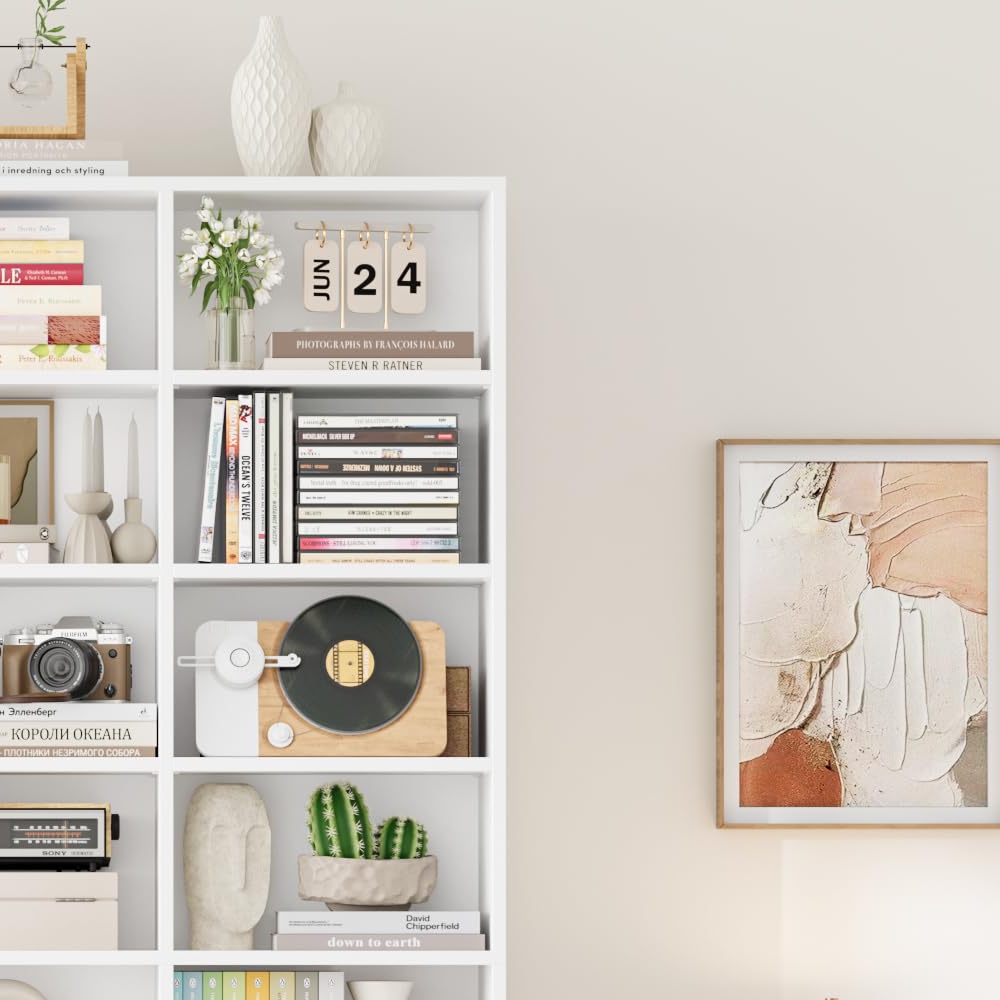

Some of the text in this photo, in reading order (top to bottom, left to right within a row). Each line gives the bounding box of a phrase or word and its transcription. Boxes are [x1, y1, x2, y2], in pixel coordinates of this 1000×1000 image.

[7, 167, 52, 176] inredning
[74, 167, 105, 176] styling
[313, 259, 330, 301] JUN
[353, 262, 421, 295] 2 4
[296, 340, 455, 351] PHOTOGRAPHS BY FRANÇOIS HALARD
[328, 361, 423, 370] STEVEN R RATNER
[229, 427, 238, 446] MAX
[241, 455, 251, 521] OCEAN'S TWELVE
[8, 708, 57, 718] Элленберг
[11, 728, 132, 740] КОРОЛИ ОКЕАНА
[3, 749, 50, 757] ПЛОТНИКИ
[52, 749, 104, 757] НЕЗРИМОГО
[105, 749, 141, 757] СОБОРА
[406, 923, 460, 931] Chipperfield
[327, 937, 421, 948] down to earth
